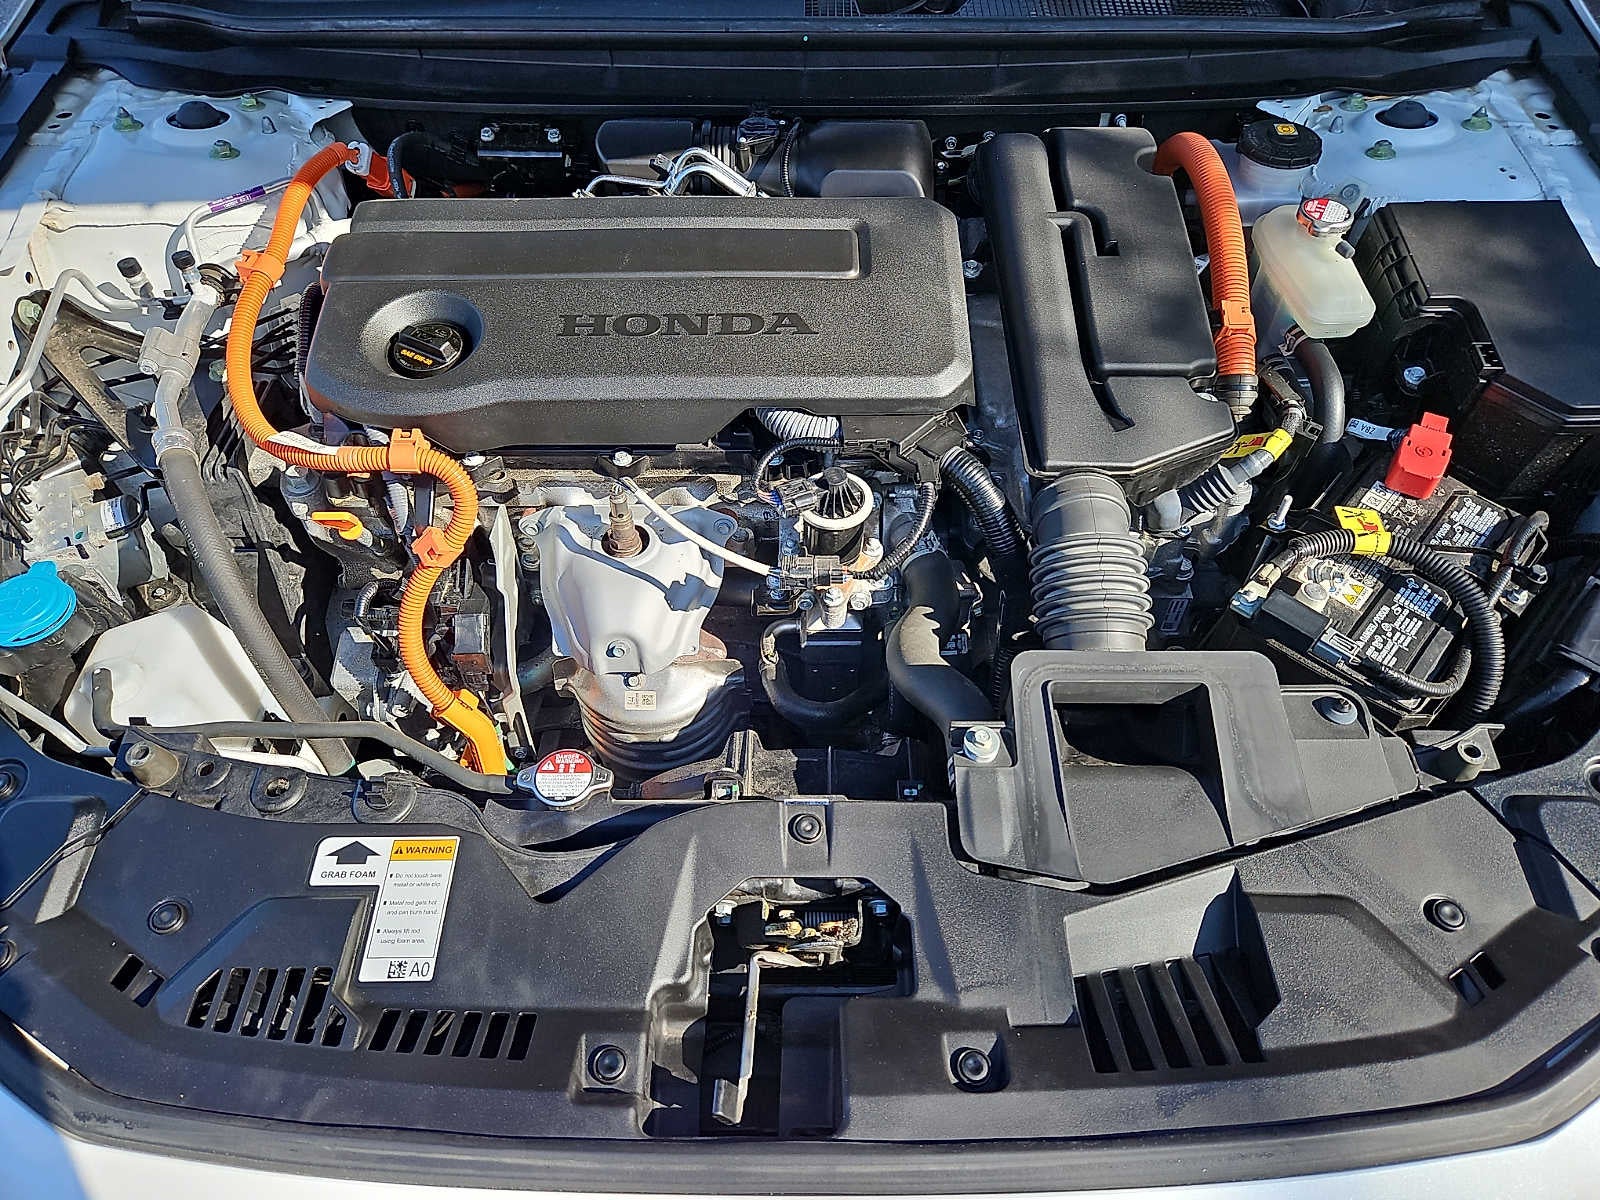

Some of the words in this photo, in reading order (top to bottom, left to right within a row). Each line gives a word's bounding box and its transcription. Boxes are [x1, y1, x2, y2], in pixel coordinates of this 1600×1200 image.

[557, 313, 819, 337] HONDA
[405, 846, 453, 855] WARNING
[320, 870, 347, 879] GRAB
[349, 870, 377, 879] FOAM
